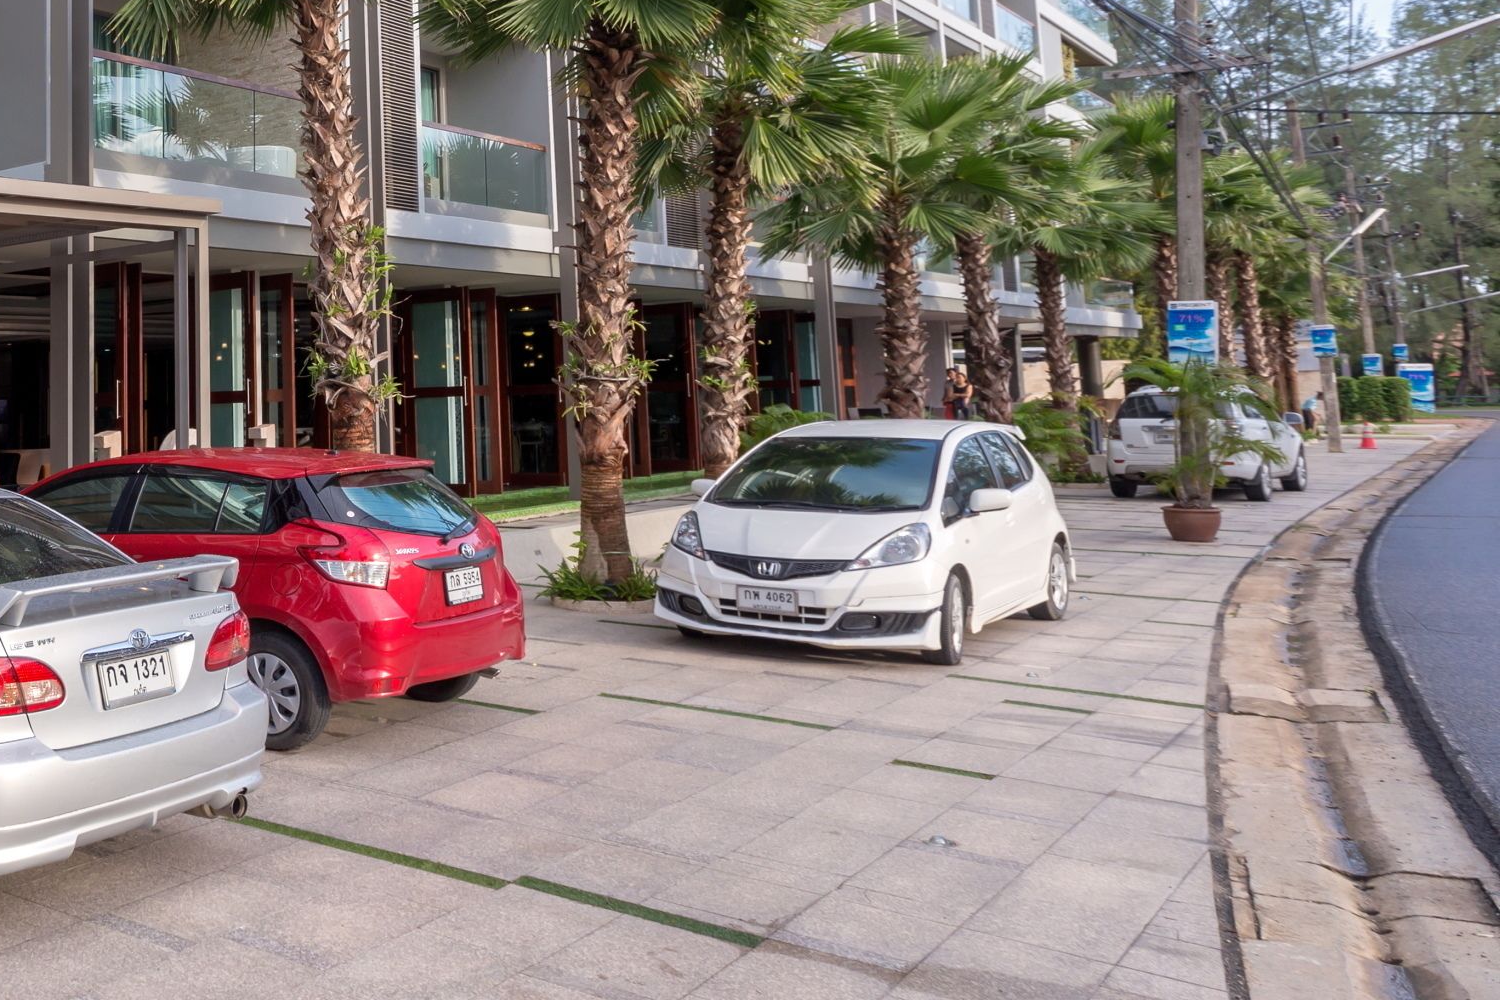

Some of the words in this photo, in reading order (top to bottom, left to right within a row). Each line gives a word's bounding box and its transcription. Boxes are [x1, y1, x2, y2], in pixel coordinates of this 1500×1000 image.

[395, 547, 420, 555] YARIS
[765, 591, 793, 603] 4062
[106, 663, 129, 687] กจ
[133, 655, 167, 681] 1321
